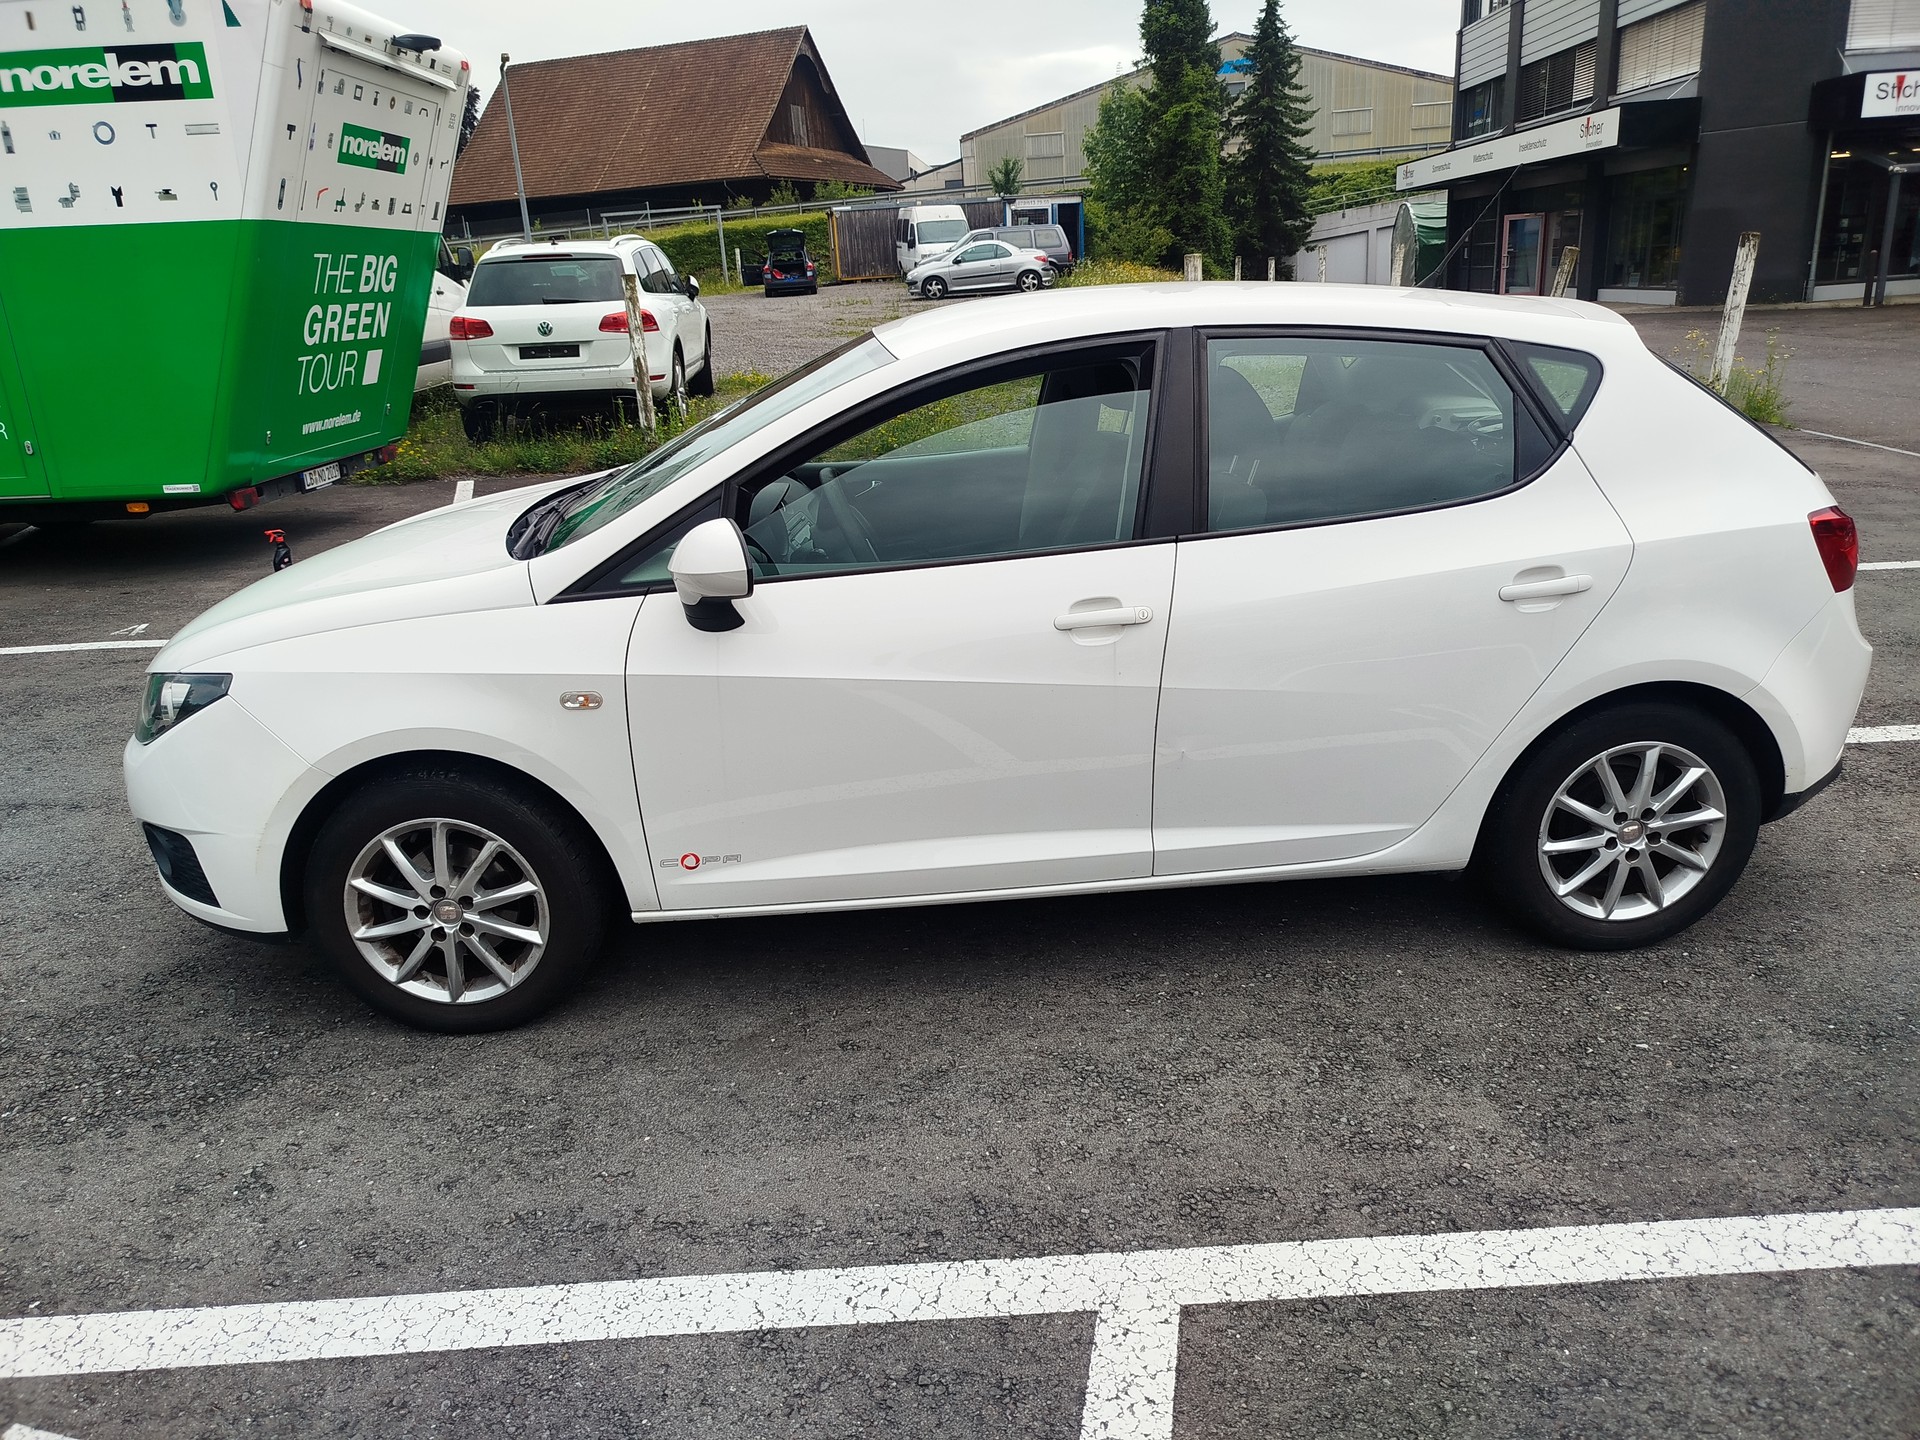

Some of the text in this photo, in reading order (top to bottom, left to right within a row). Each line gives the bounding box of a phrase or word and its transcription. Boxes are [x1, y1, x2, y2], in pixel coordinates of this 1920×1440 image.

[0, 53, 201, 93] norelem
[342, 135, 406, 165] norelem
[313, 253, 398, 294] THE BIG
[303, 302, 391, 346] GREEN
[297, 350, 358, 395] TOUR
[302, 410, 361, 435] www.norelem.de
